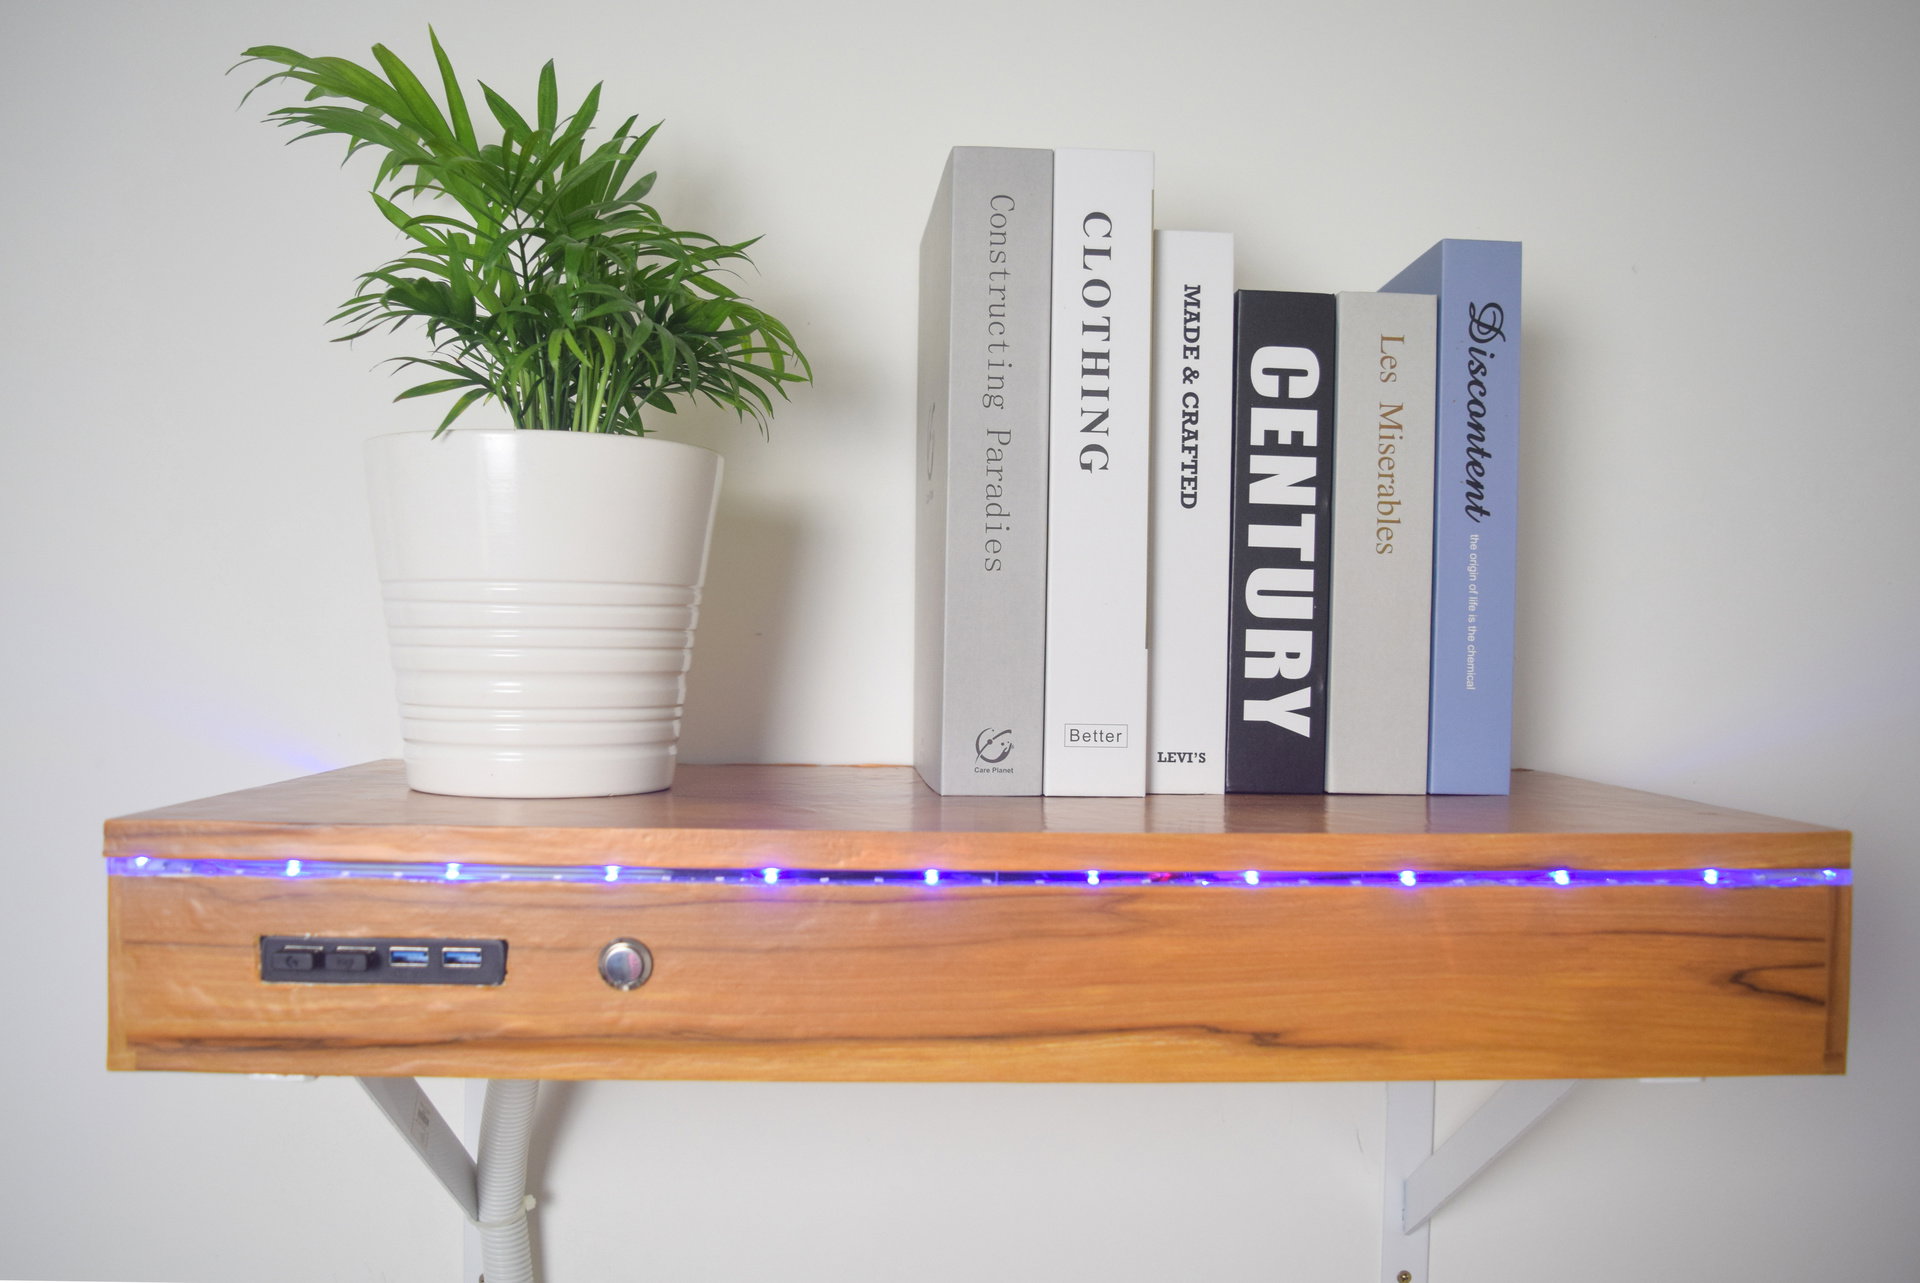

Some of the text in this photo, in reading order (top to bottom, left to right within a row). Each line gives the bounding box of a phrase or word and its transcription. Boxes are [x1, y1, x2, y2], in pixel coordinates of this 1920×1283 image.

[981, 194, 1016, 572] Constructing Paradies
[1079, 211, 1113, 474] CLOTHING
[1180, 284, 1201, 510] MADE & CRAFTED
[1375, 334, 1406, 555] Les Miserables
[1464, 301, 1507, 524] Discontent
[1242, 345, 1321, 738] CENTURY
[1465, 534, 1480, 690] the origin of life is the chemical
[991, 766, 1014, 774] Planet
[1069, 728, 1123, 743] Better
